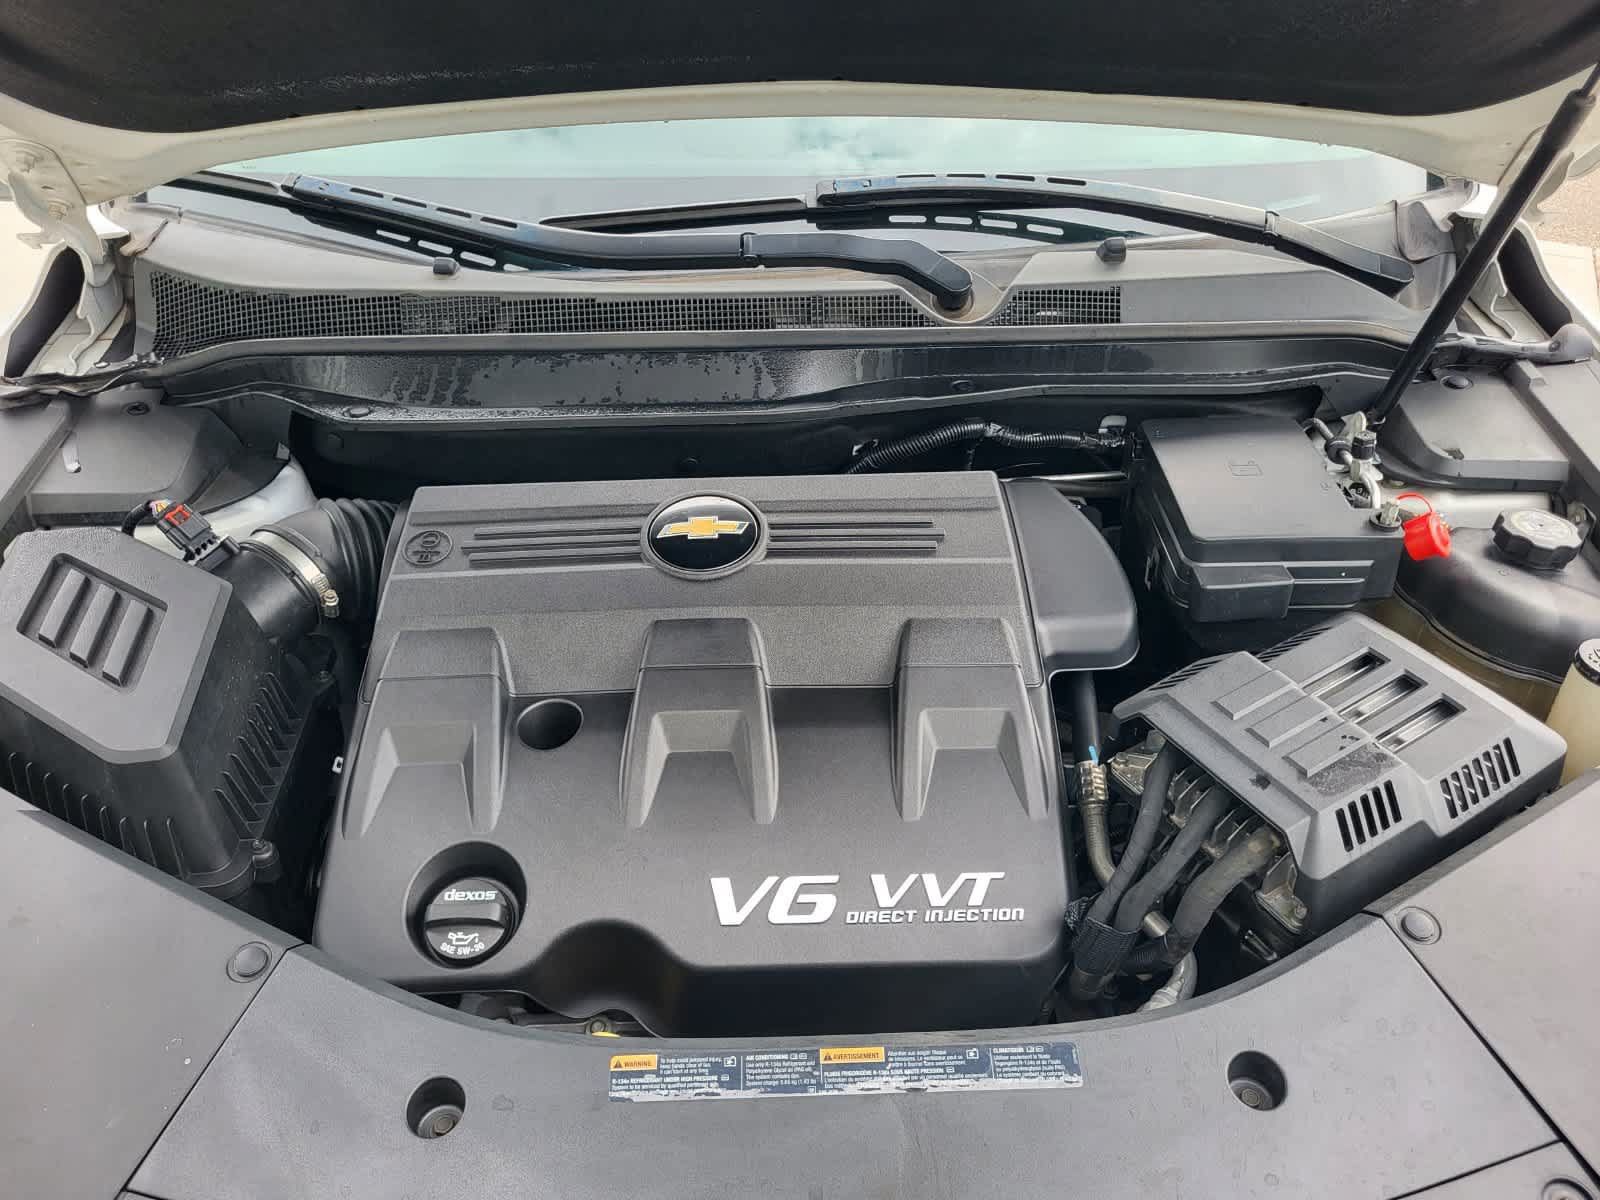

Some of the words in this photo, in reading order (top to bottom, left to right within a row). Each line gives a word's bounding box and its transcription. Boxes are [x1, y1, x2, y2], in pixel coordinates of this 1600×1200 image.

[443, 888, 498, 901] dexos
[710, 875, 839, 926] V6
[870, 872, 1005, 908] VVT
[845, 909, 918, 924] DIRECT
[924, 908, 1024, 923] INJECTION
[440, 942, 457, 954] SAE
